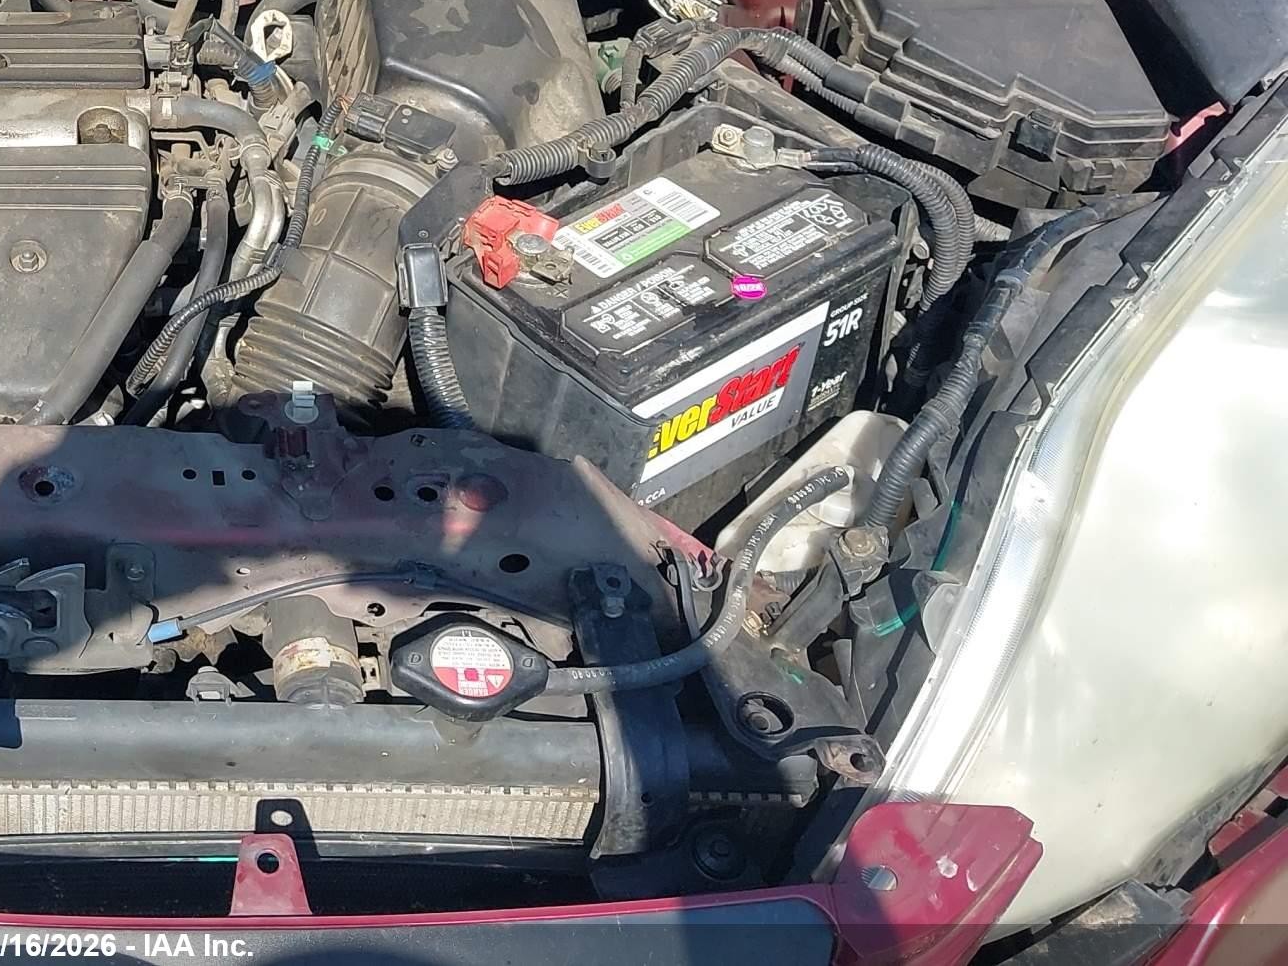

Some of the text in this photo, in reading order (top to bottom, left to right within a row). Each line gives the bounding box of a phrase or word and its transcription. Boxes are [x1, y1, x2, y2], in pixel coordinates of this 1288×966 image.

[598, 287, 638, 310] DANGER
[641, 267, 677, 290] POISON
[823, 307, 863, 347] 51R
[730, 395, 777, 429] VALUE
[645, 487, 666, 504] CCA
